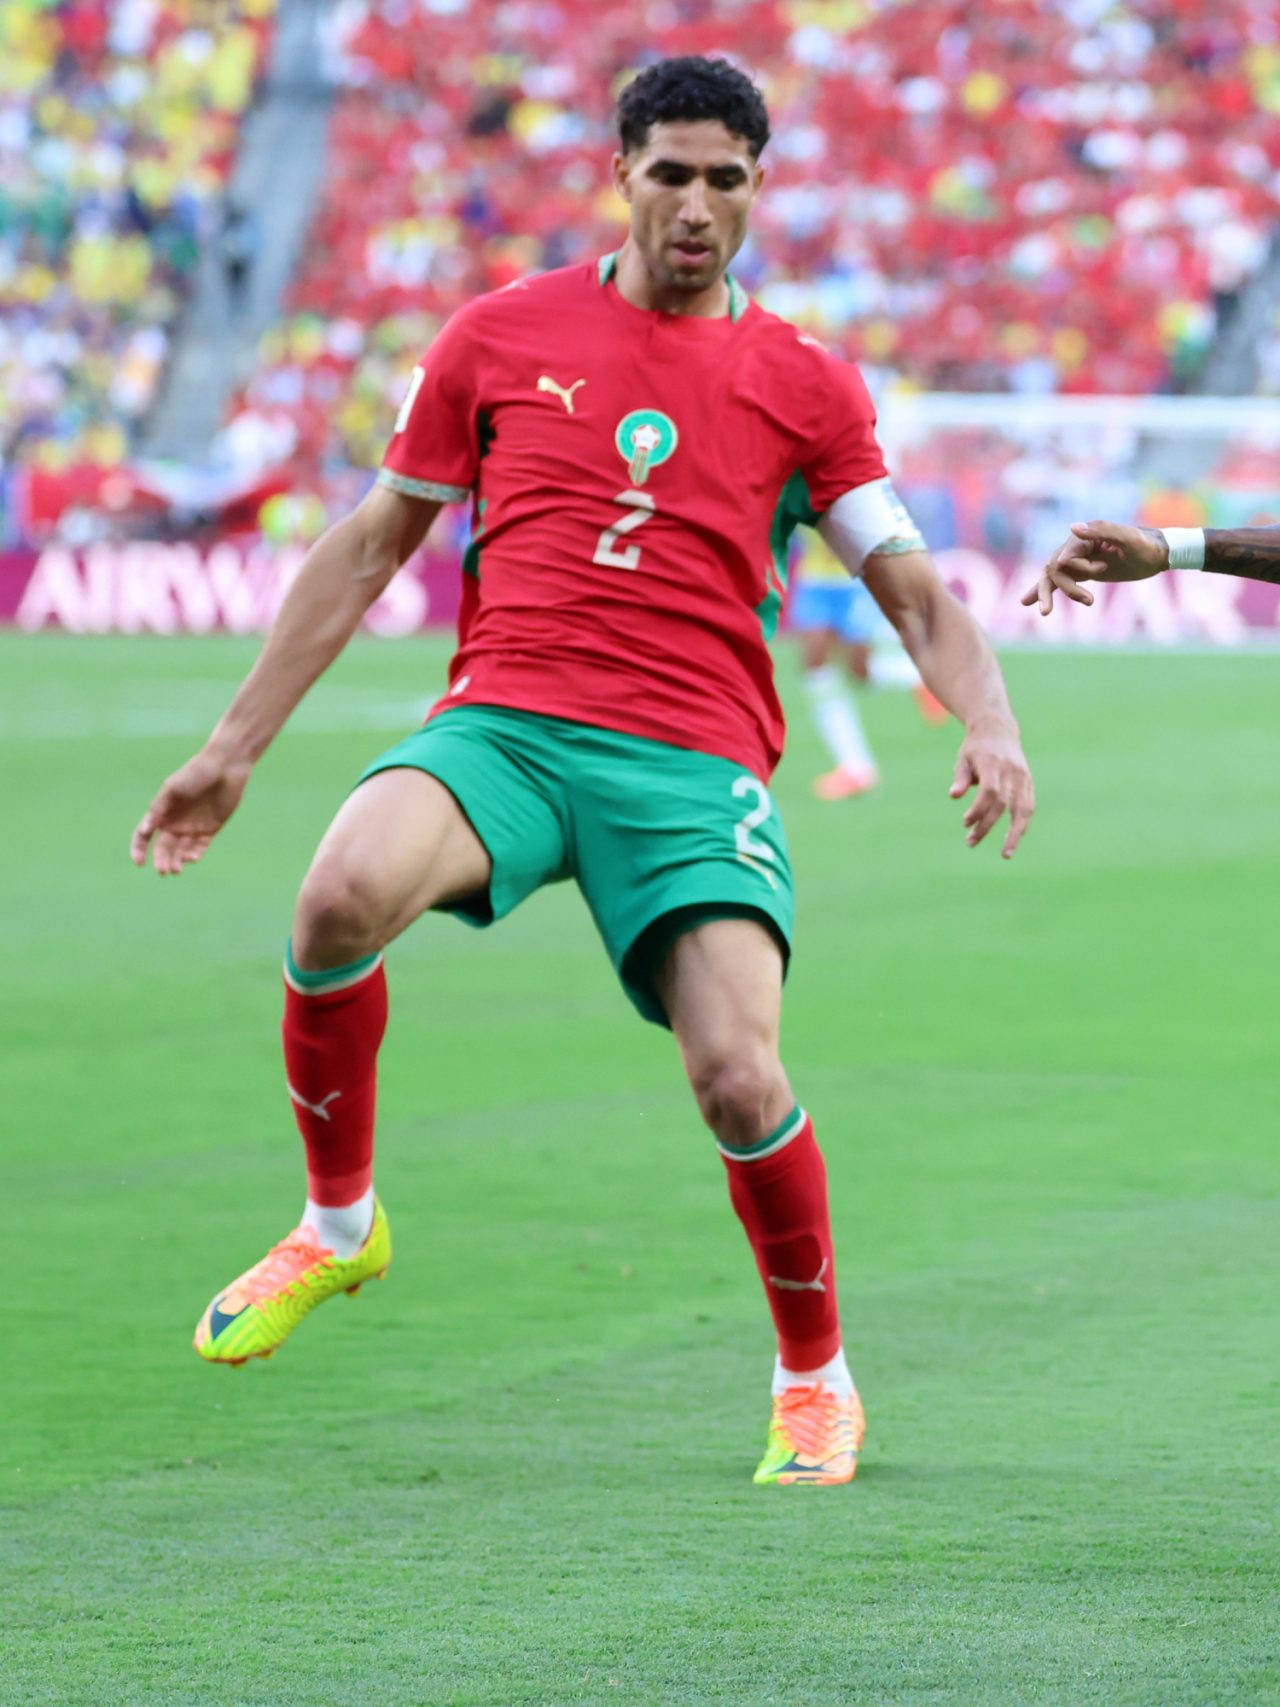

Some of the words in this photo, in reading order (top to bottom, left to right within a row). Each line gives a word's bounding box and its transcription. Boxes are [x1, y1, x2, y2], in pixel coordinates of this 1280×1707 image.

[592, 488, 656, 571] 2
[16, 544, 427, 635] AIRWS
[731, 775, 775, 861] 2
